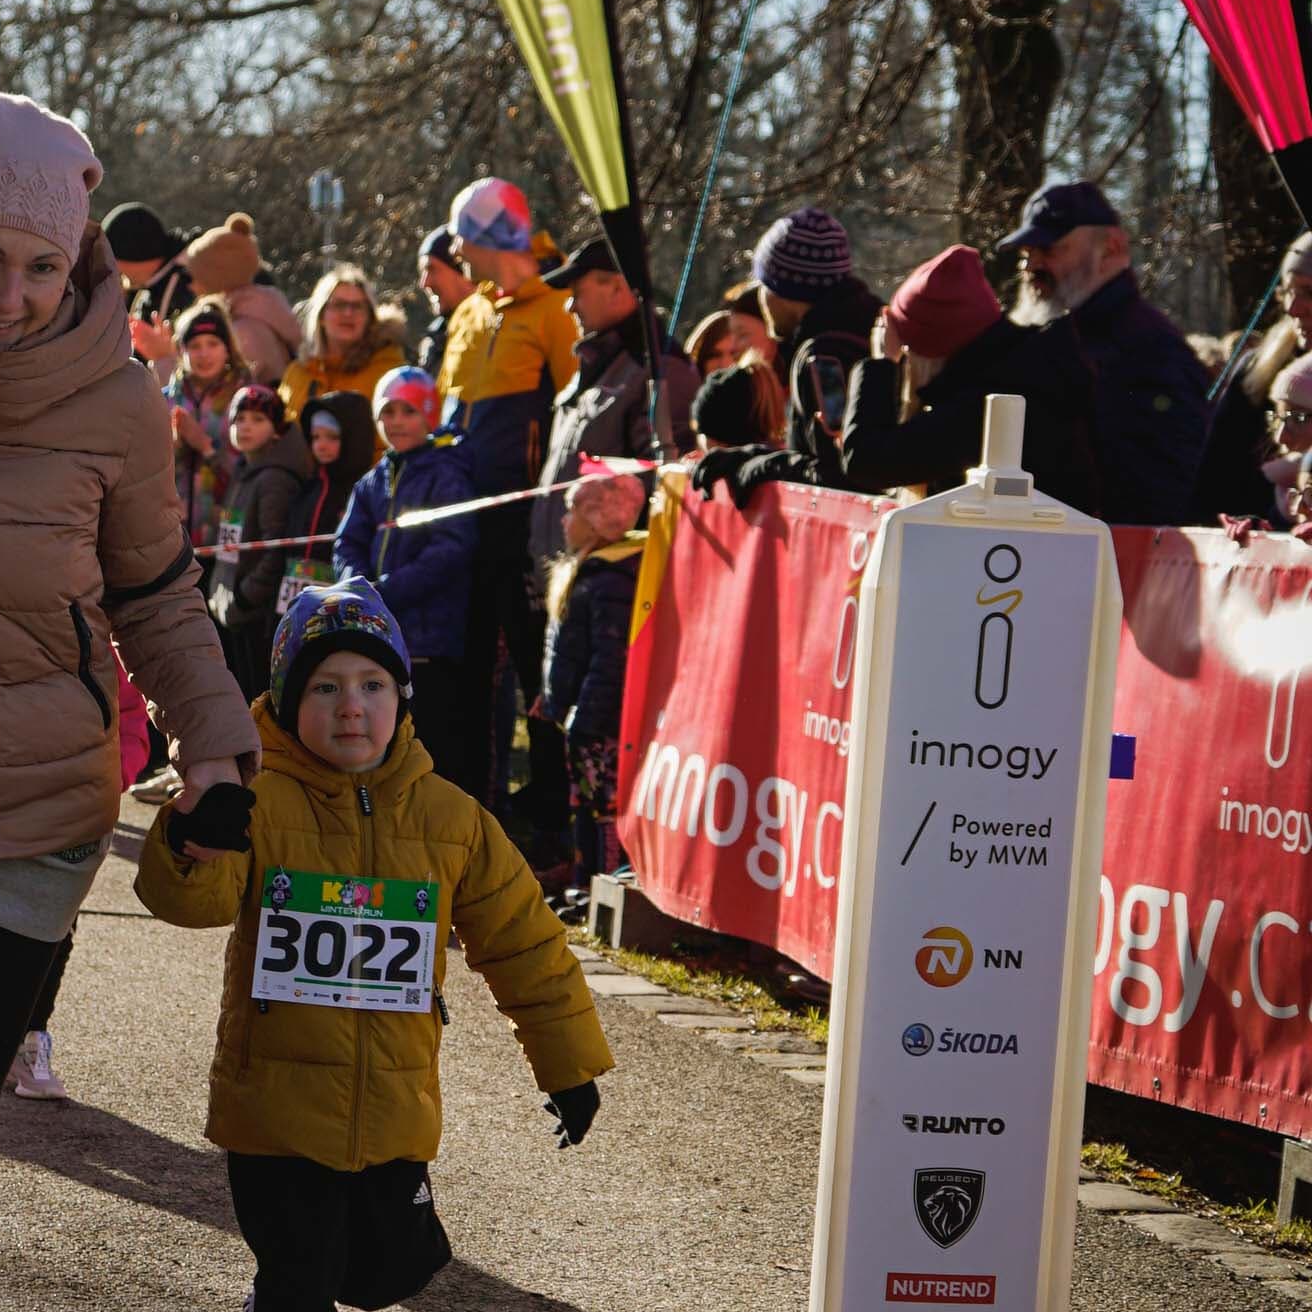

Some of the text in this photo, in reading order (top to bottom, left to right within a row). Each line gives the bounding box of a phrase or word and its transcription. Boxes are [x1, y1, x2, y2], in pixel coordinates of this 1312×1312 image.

[909, 729, 1058, 780] innogy
[952, 814, 1052, 839] Powered
[949, 842, 1048, 869] by MVM
[261, 913, 422, 984] 3022
[983, 949, 1023, 970] NN
[937, 1028, 1019, 1056] ŠKODA
[921, 1116, 1006, 1136] RUNTO
[920, 1174, 979, 1185] PEUGEOT
[892, 1279, 991, 1299] NUTREND
